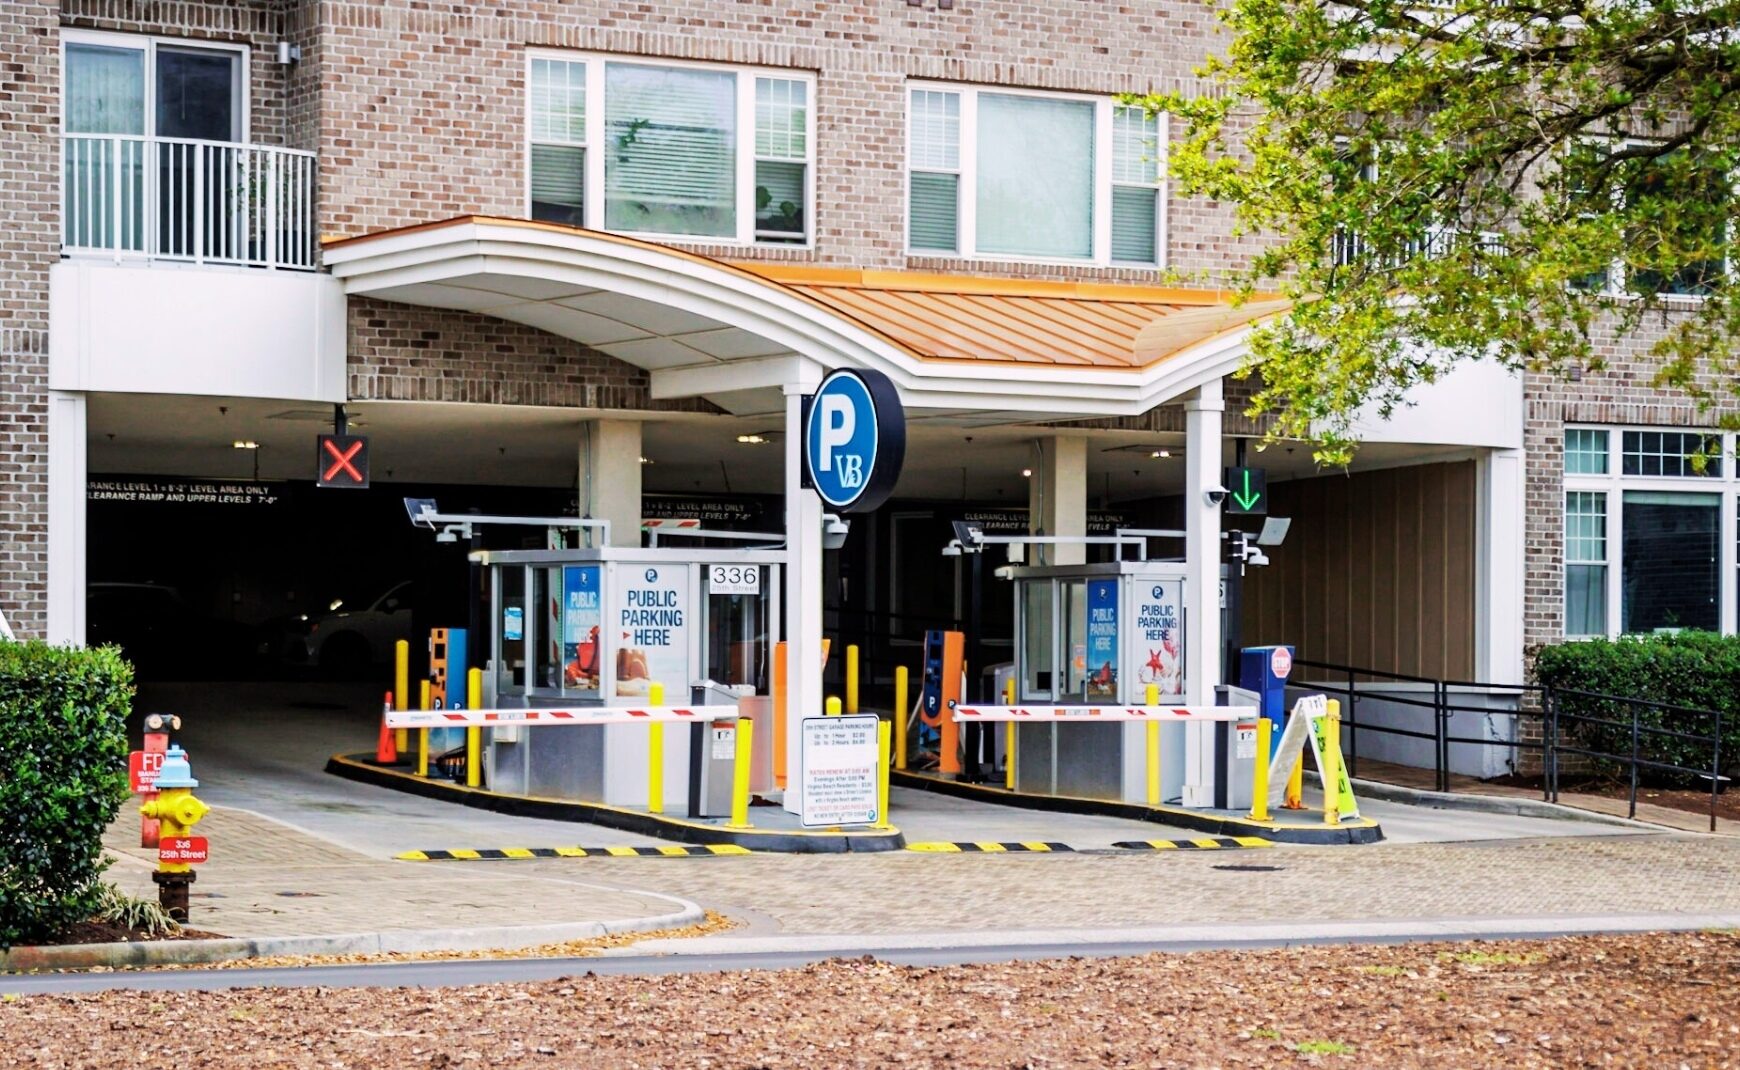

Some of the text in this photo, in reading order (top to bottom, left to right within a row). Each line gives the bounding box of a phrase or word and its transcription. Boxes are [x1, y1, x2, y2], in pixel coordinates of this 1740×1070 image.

[820, 394, 856, 471] P
[123, 482, 152, 492] LEVEL
[190, 484, 218, 493] LEVEL
[220, 485, 244, 494] AREA
[245, 486, 269, 495] ONLY
[86, 491, 137, 501] LEARANCE
[138, 492, 165, 501] RAMP
[166, 493, 185, 502] AND
[187, 494, 217, 503] UPPER
[218, 495, 252, 504] LEVELS
[724, 504, 745, 512] ONLY
[964, 513, 1008, 521] CLEARANCE
[713, 567, 757, 584] 336
[733, 584, 758, 592] Street
[570, 592, 597, 608] PUBLIC
[628, 590, 677, 607] PUBLIC
[1092, 608, 1114, 622] PUBLIC
[1141, 604, 1174, 617] PUBLIC
[621, 609, 683, 627] PARKING
[1138, 617, 1177, 628] PARKING
[1090, 622, 1117, 636] PARKING
[1146, 630, 1170, 640] HERE
[634, 629, 670, 646] HERE
[1095, 637, 1111, 650] HERE
[929, 696, 935, 708] P
[142, 753, 165, 770] FD
[175, 840, 191, 849] 336
[161, 850, 206, 859] 25th Street
